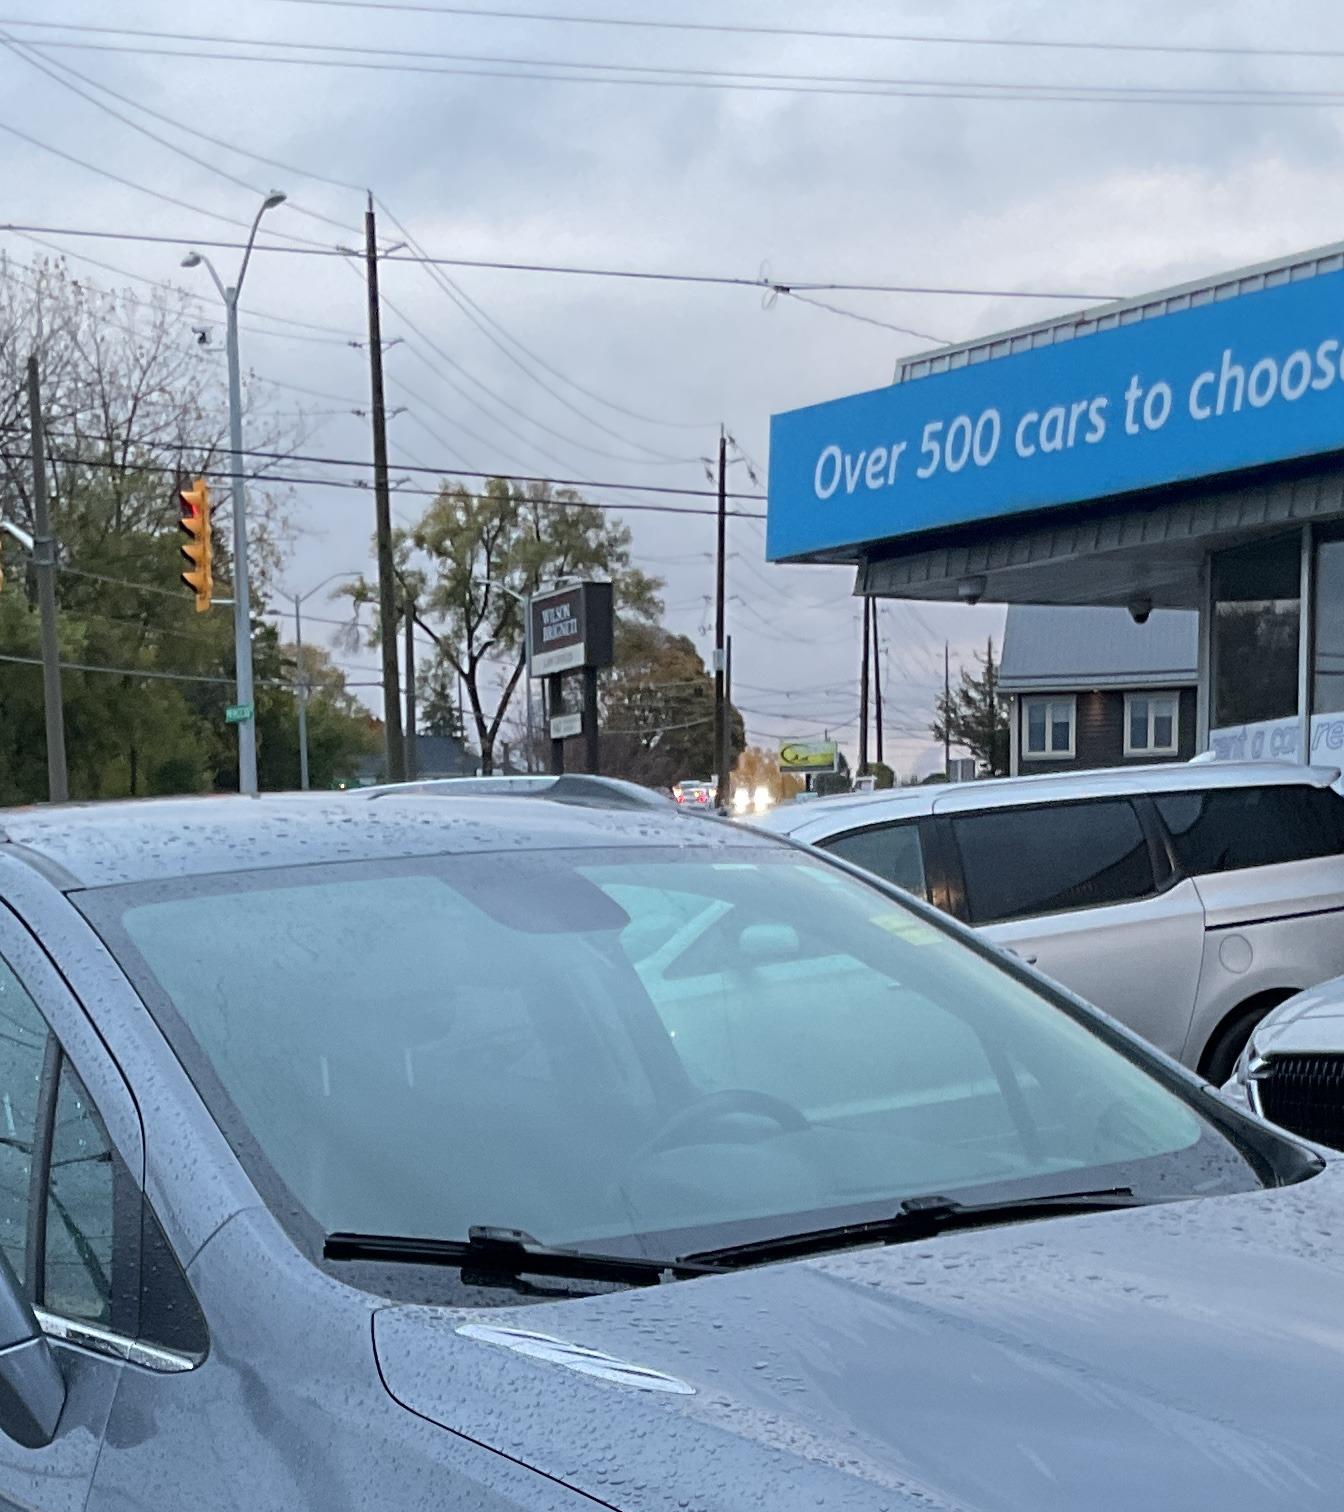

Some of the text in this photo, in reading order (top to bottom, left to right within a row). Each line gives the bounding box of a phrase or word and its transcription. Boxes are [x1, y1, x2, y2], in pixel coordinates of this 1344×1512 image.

[814, 441, 907, 500] Over
[916, 408, 1001, 479] 500
[1015, 397, 1108, 458] cars
[1124, 374, 1172, 436] to
